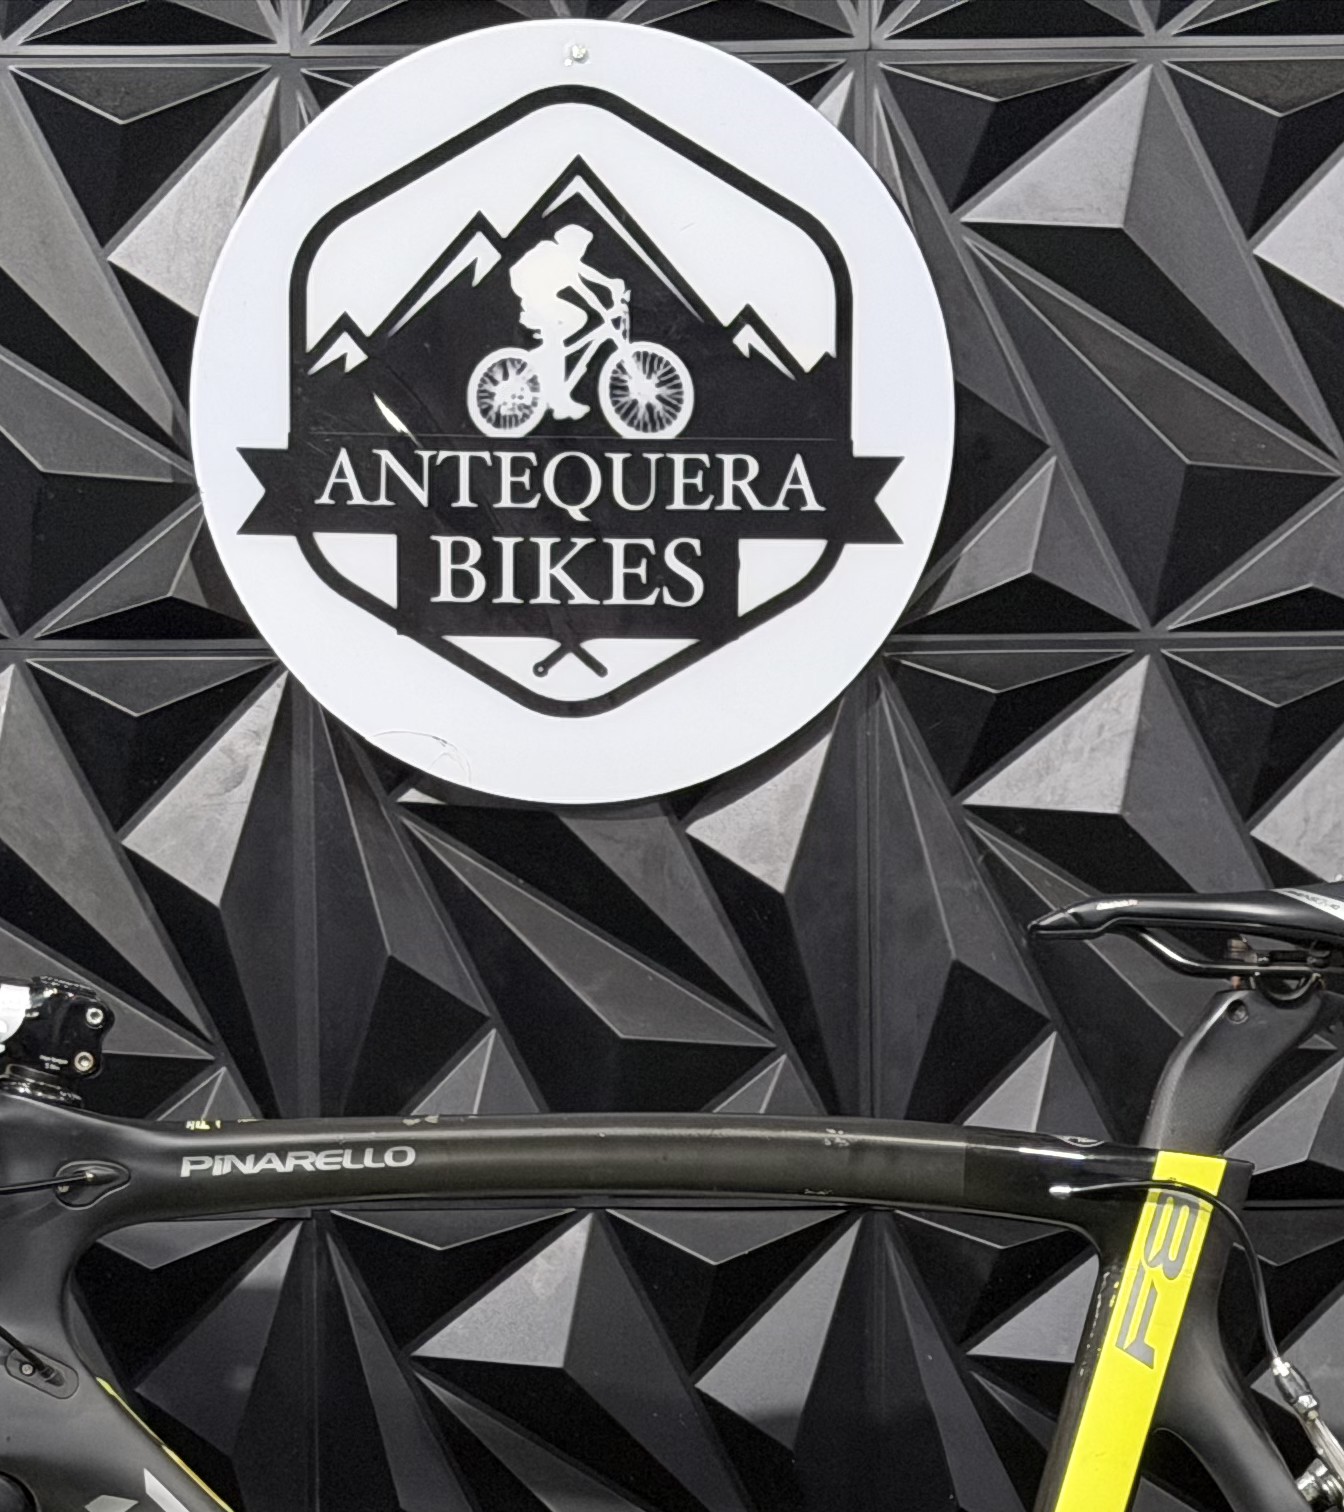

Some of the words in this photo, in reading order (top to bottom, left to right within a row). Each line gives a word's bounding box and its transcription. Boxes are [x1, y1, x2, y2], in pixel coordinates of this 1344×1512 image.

[314, 447, 826, 521] ANTEQUERA
[430, 535, 704, 607] BIKES
[180, 1146, 416, 1178] PINARELLO
